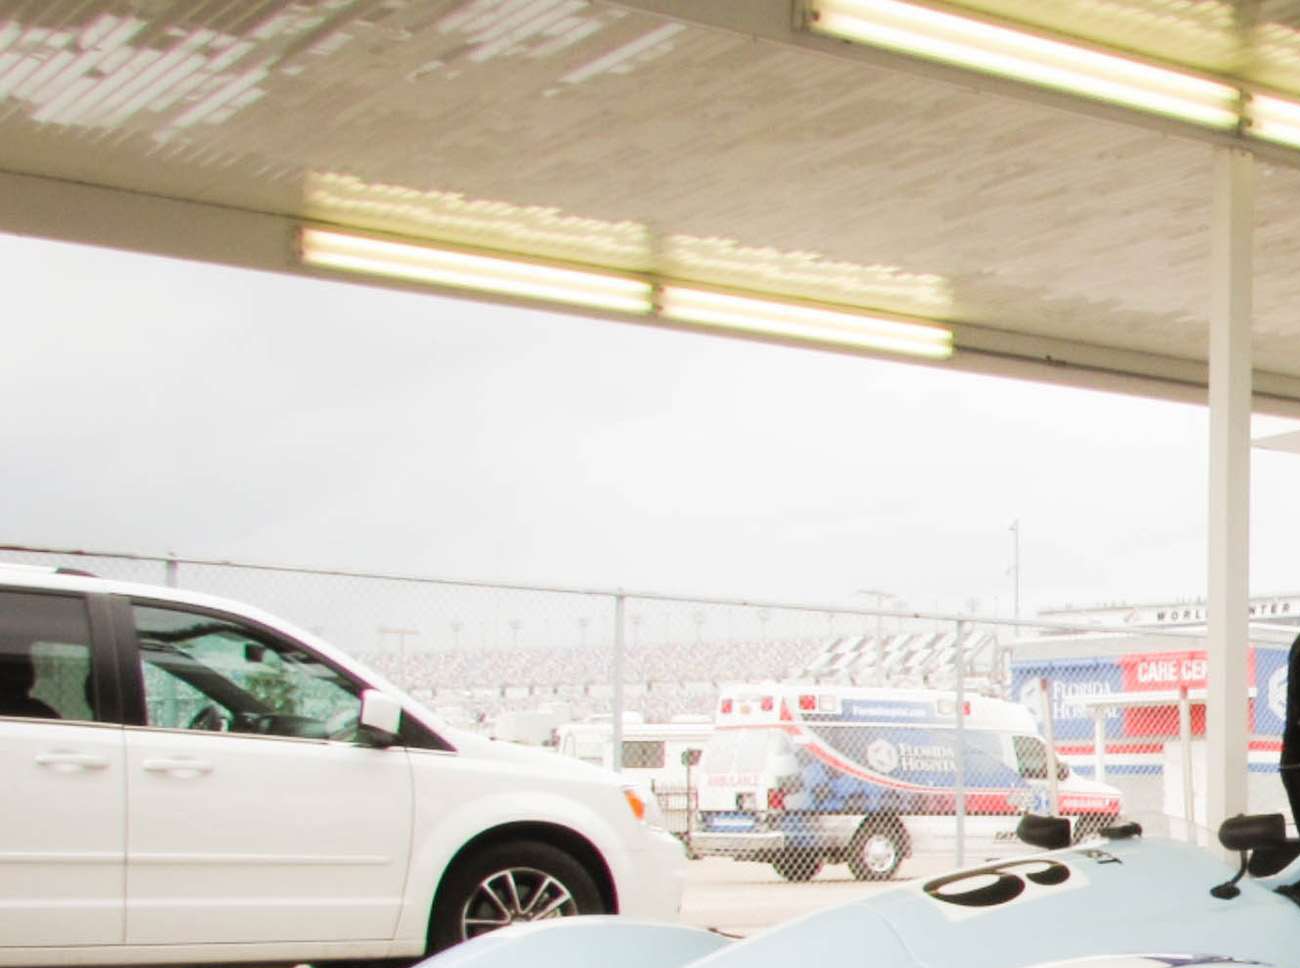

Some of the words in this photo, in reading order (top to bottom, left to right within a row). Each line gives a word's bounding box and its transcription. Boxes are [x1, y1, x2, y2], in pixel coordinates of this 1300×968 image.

[1157, 608, 1208, 622] WORL
[1249, 603, 1290, 616] NTER
[1137, 661, 1177, 682] CARE
[901, 757, 958, 772] HOSPITA
